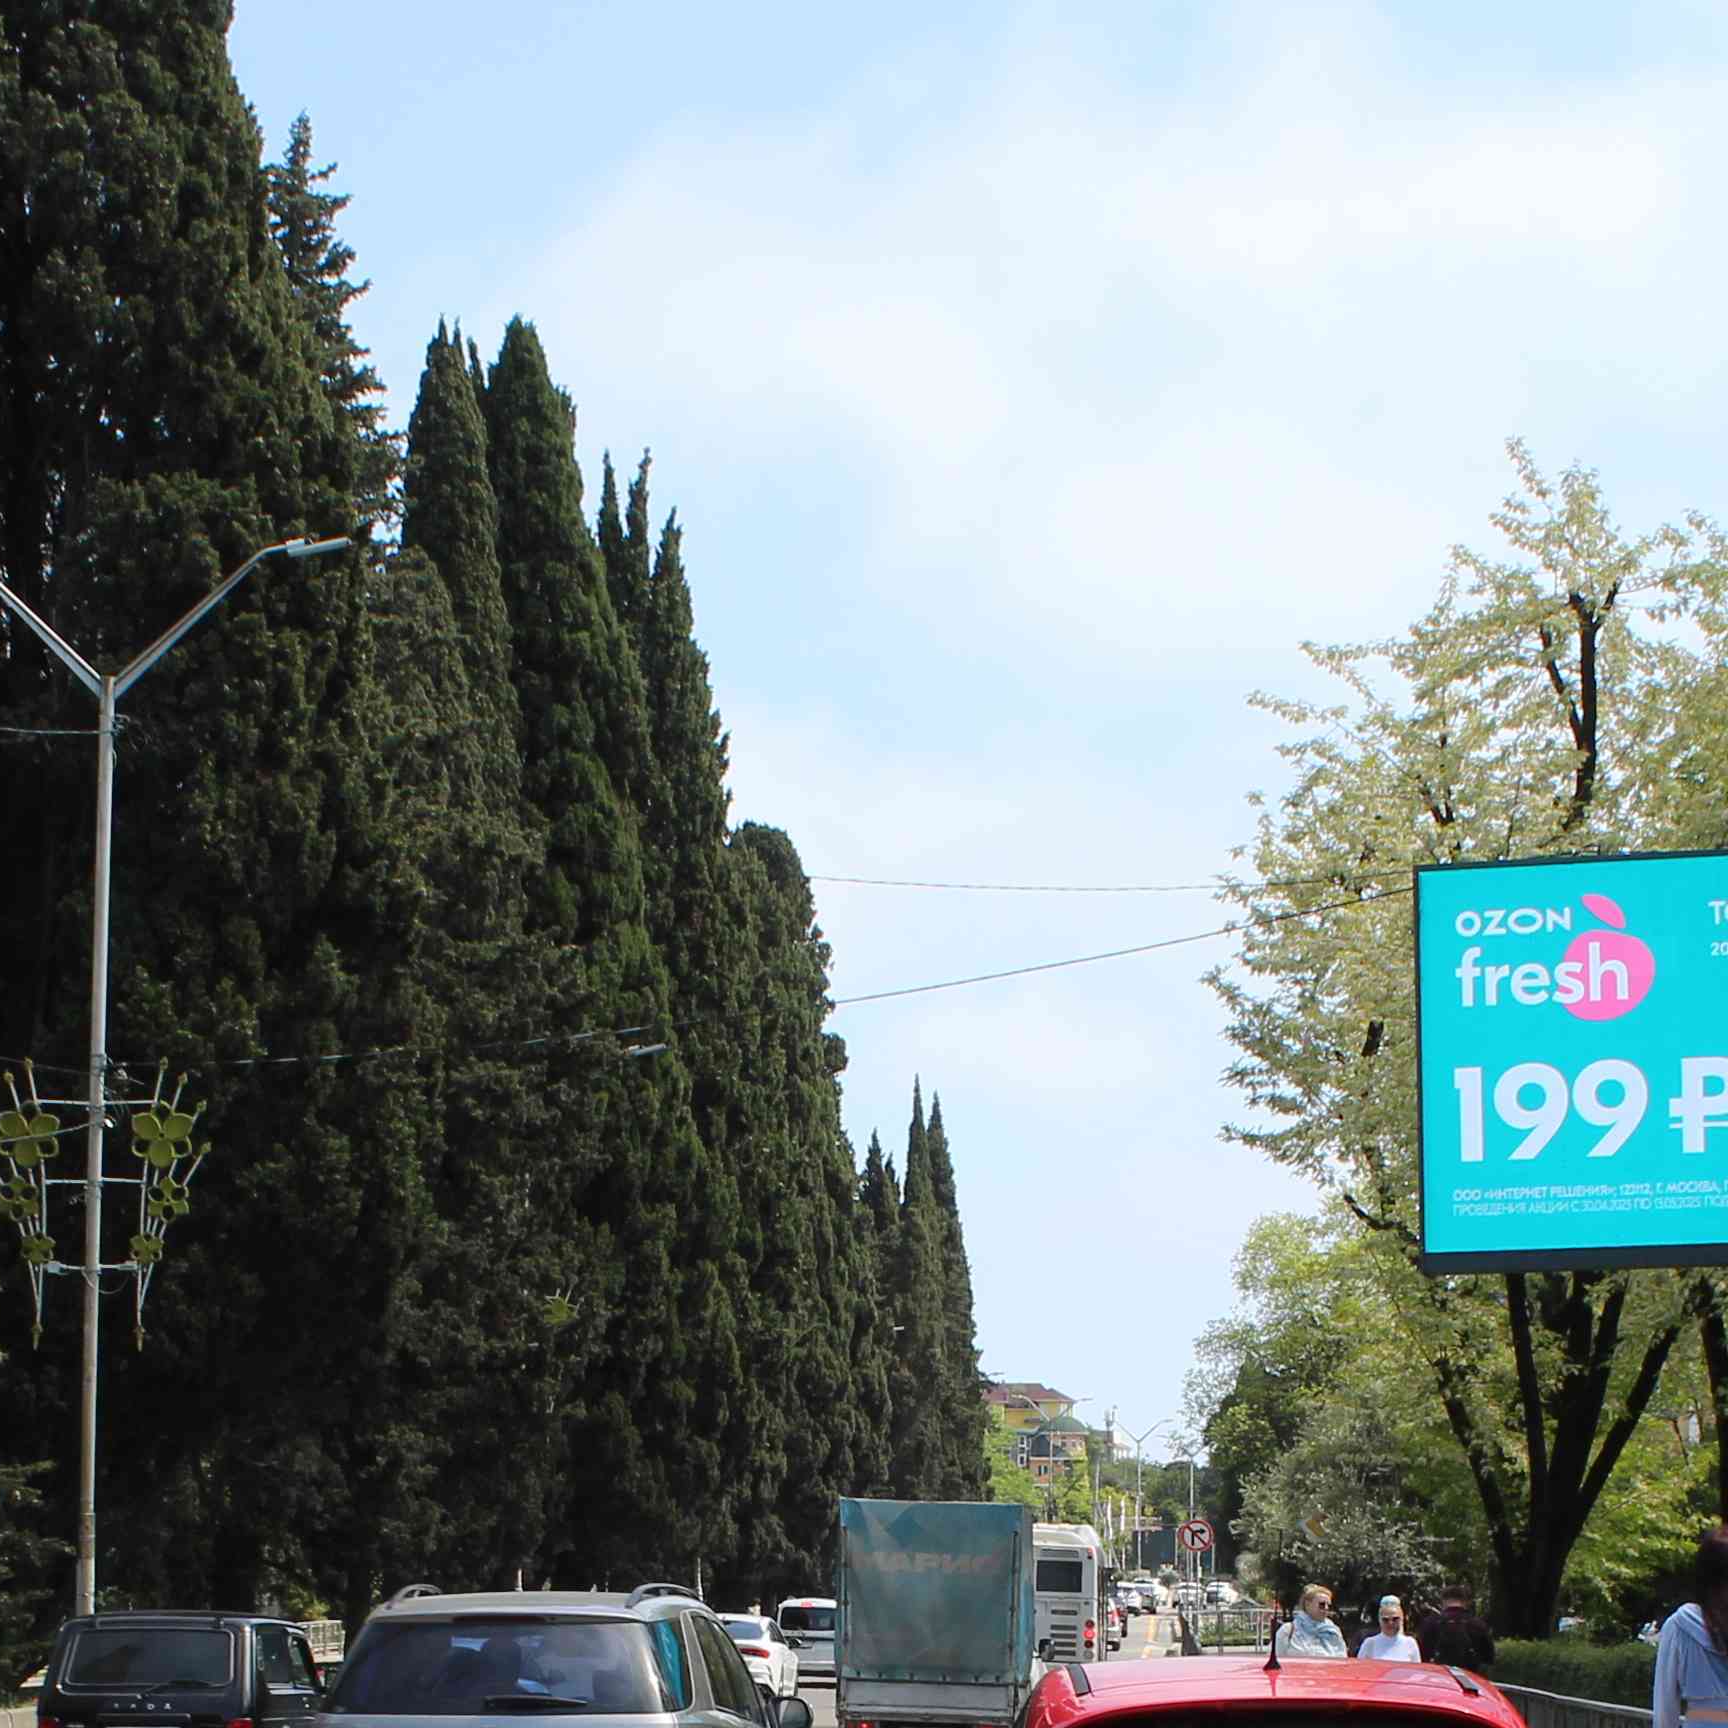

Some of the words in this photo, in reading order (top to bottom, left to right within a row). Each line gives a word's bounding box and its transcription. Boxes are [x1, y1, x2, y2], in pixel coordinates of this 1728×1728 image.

[1455, 907, 1571, 937] OZON
[1455, 942, 1629, 1007] fresh
[1454, 1059, 1649, 1162] 199
